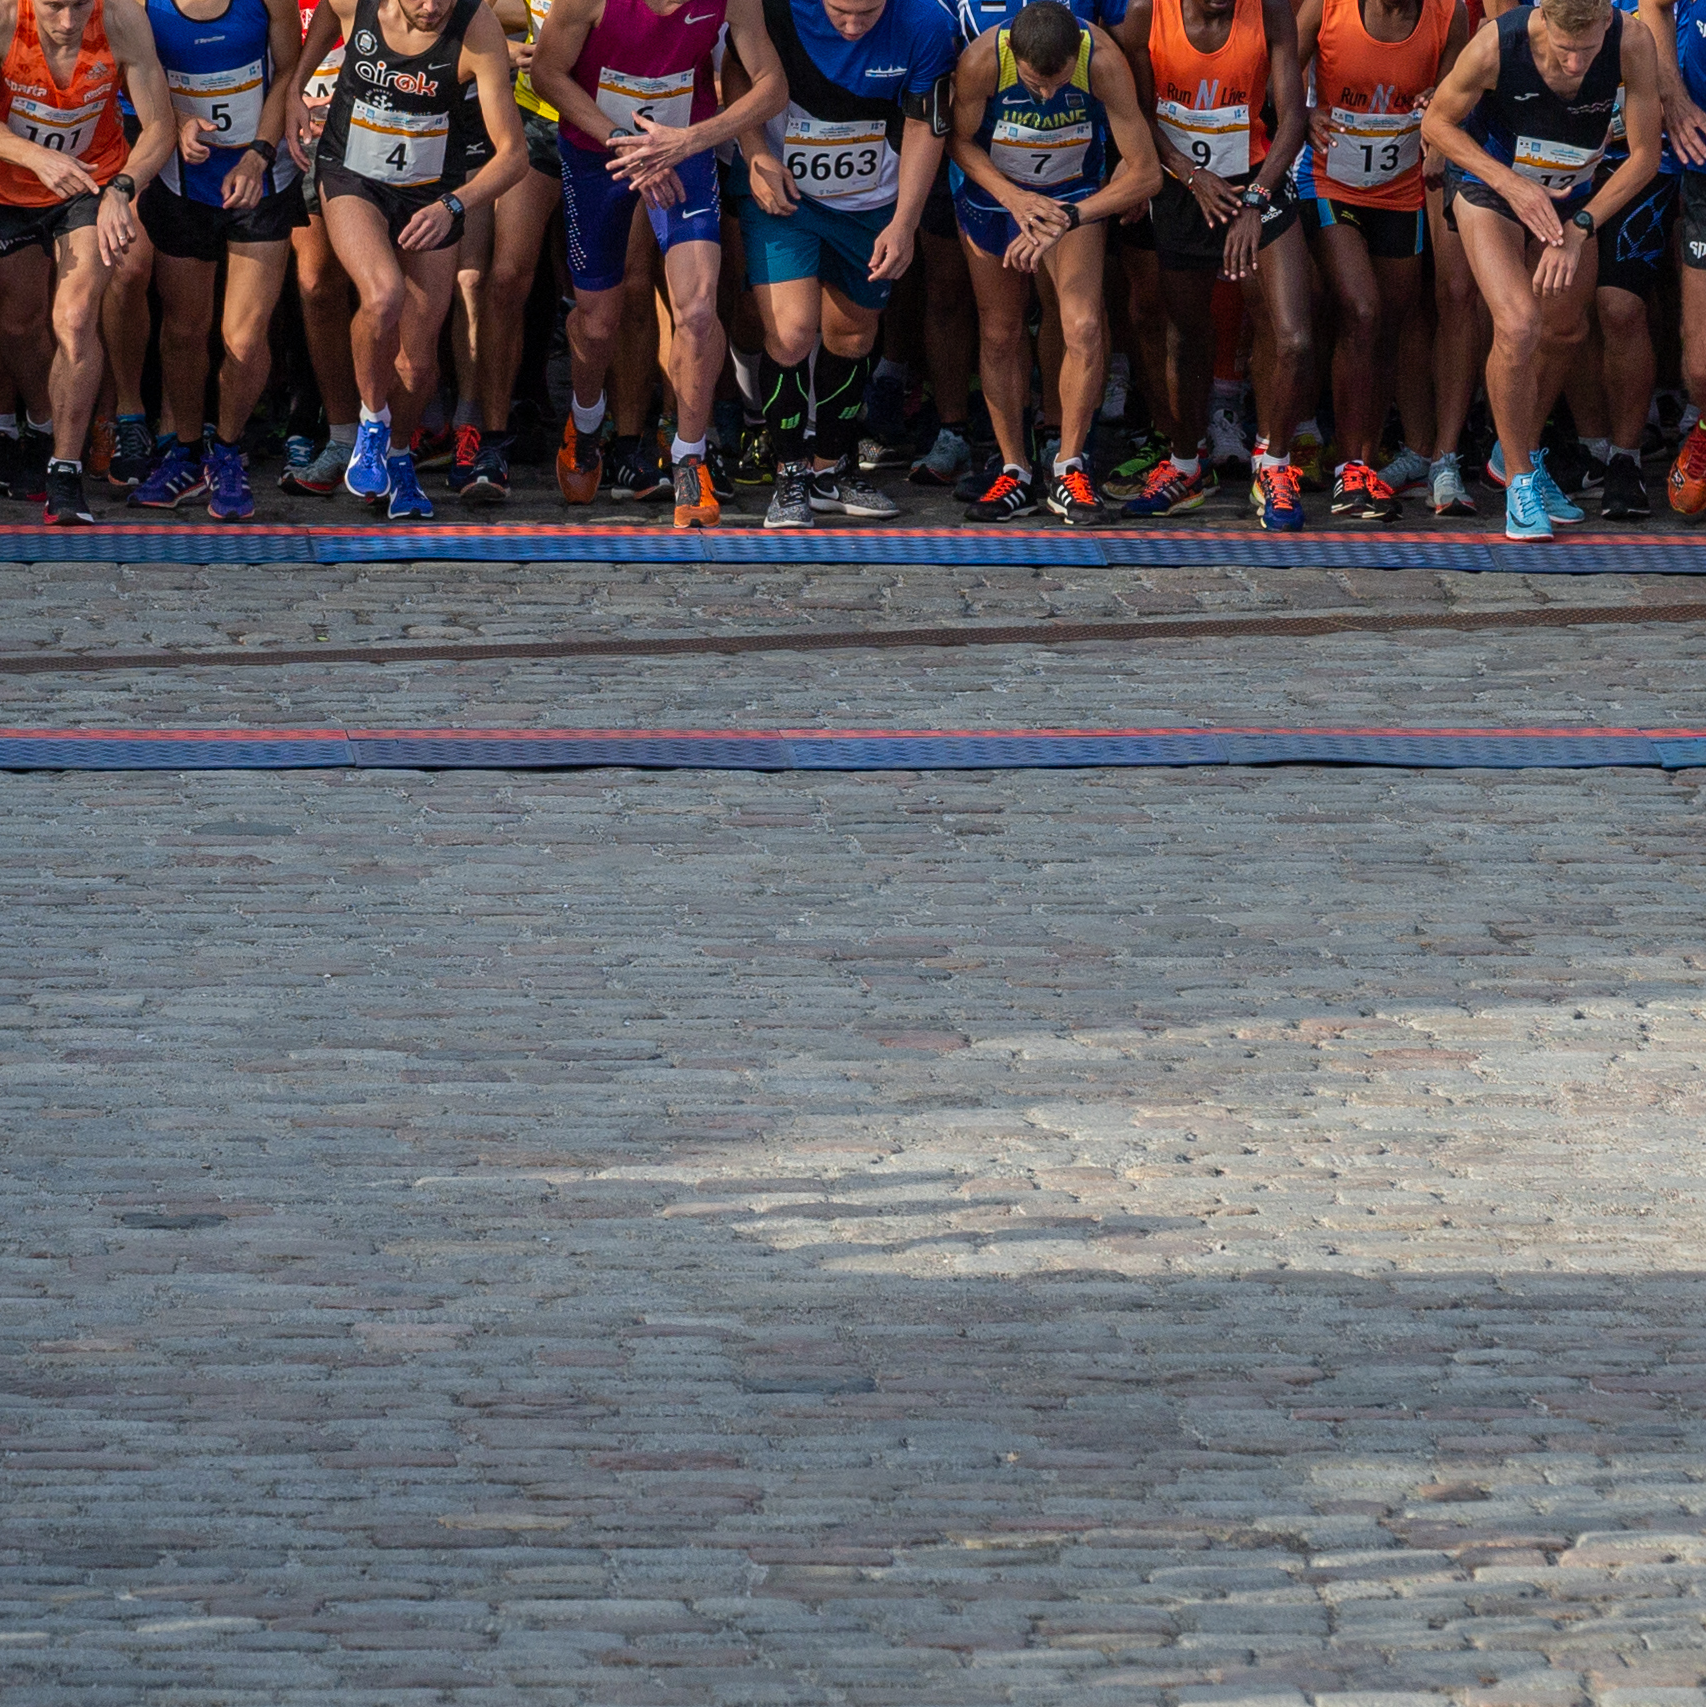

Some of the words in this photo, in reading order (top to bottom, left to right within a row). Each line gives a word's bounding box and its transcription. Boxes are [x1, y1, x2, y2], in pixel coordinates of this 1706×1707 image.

[1167, 82, 1192, 105] Run
[1194, 79, 1220, 111] N
[1221, 86, 1247, 107] Live
[1341, 87, 1368, 108] Run
[1368, 84, 1395, 114] N
[209, 103, 232, 132] 5
[1003, 108, 1087, 130] UKRAINE
[25, 124, 83, 152] 101
[385, 143, 407, 172] 4
[787, 149, 878, 181] 6663
[1031, 153, 1053, 175] 7
[1192, 140, 1211, 167] 9
[1359, 144, 1400, 173] 13
